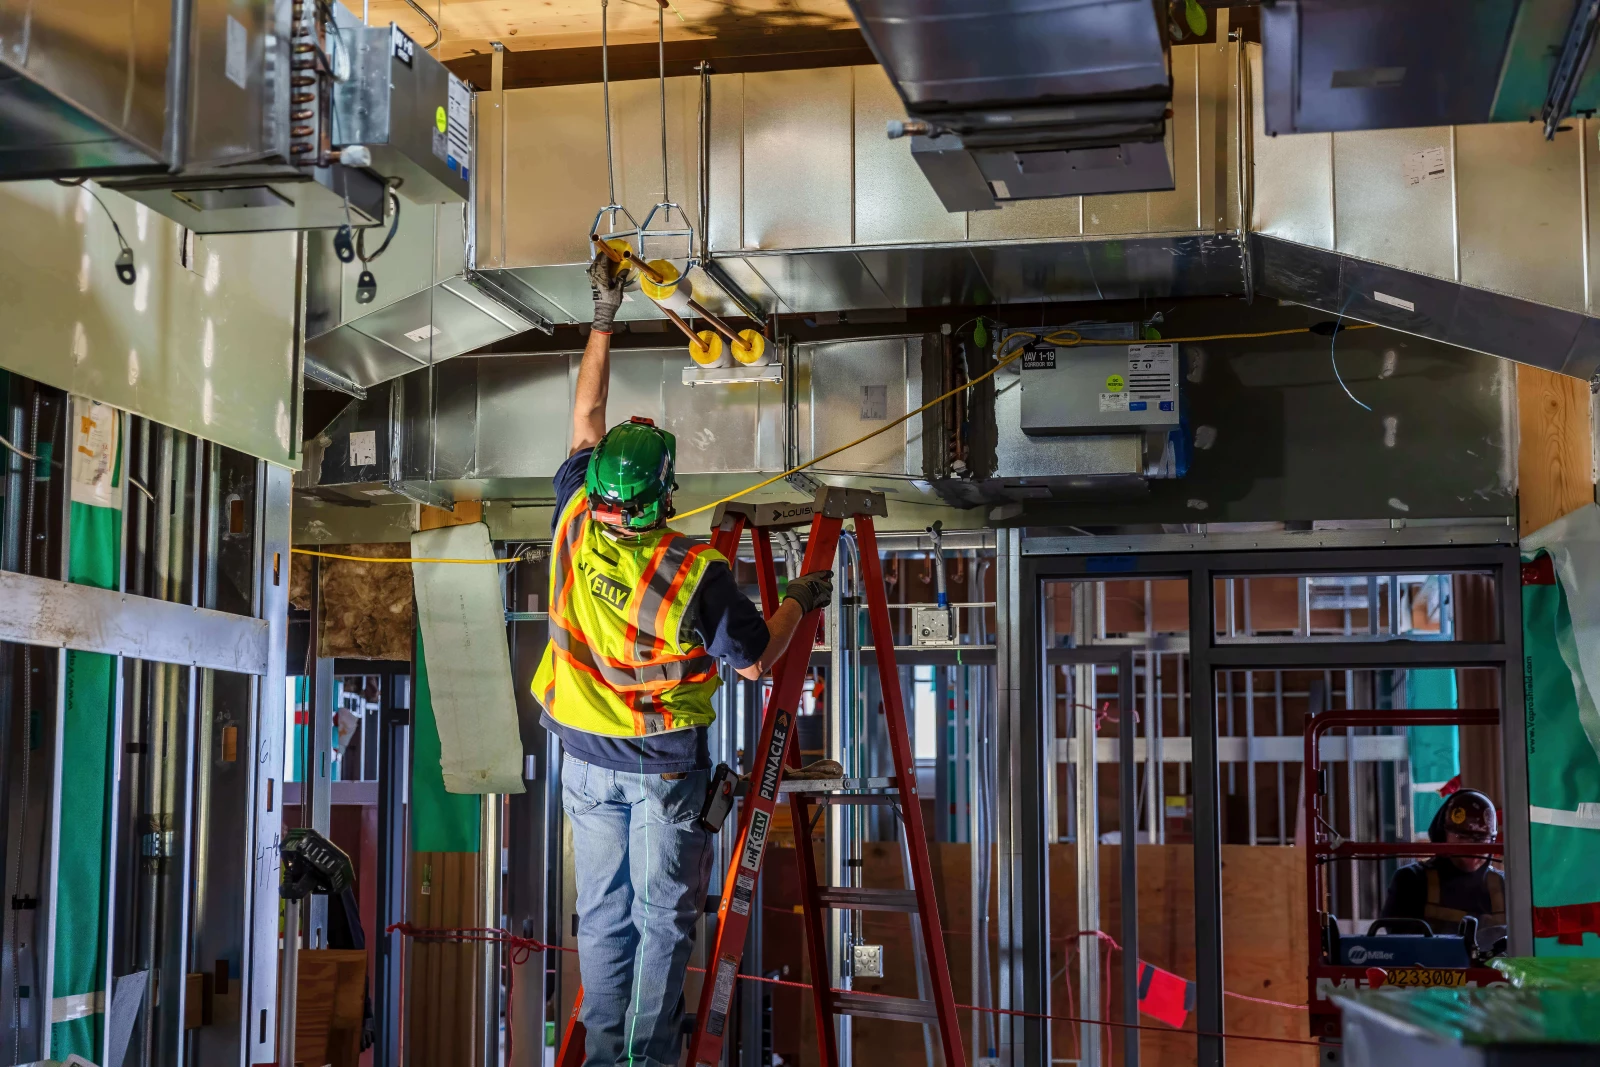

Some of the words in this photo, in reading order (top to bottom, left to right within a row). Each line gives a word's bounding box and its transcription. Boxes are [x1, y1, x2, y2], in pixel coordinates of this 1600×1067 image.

[1038, 351, 1055, 361] 1-19
[760, 728, 786, 801] PINNACLE
[1367, 950, 1394, 960] Miller
[1387, 970, 1465, 985] 0233007
